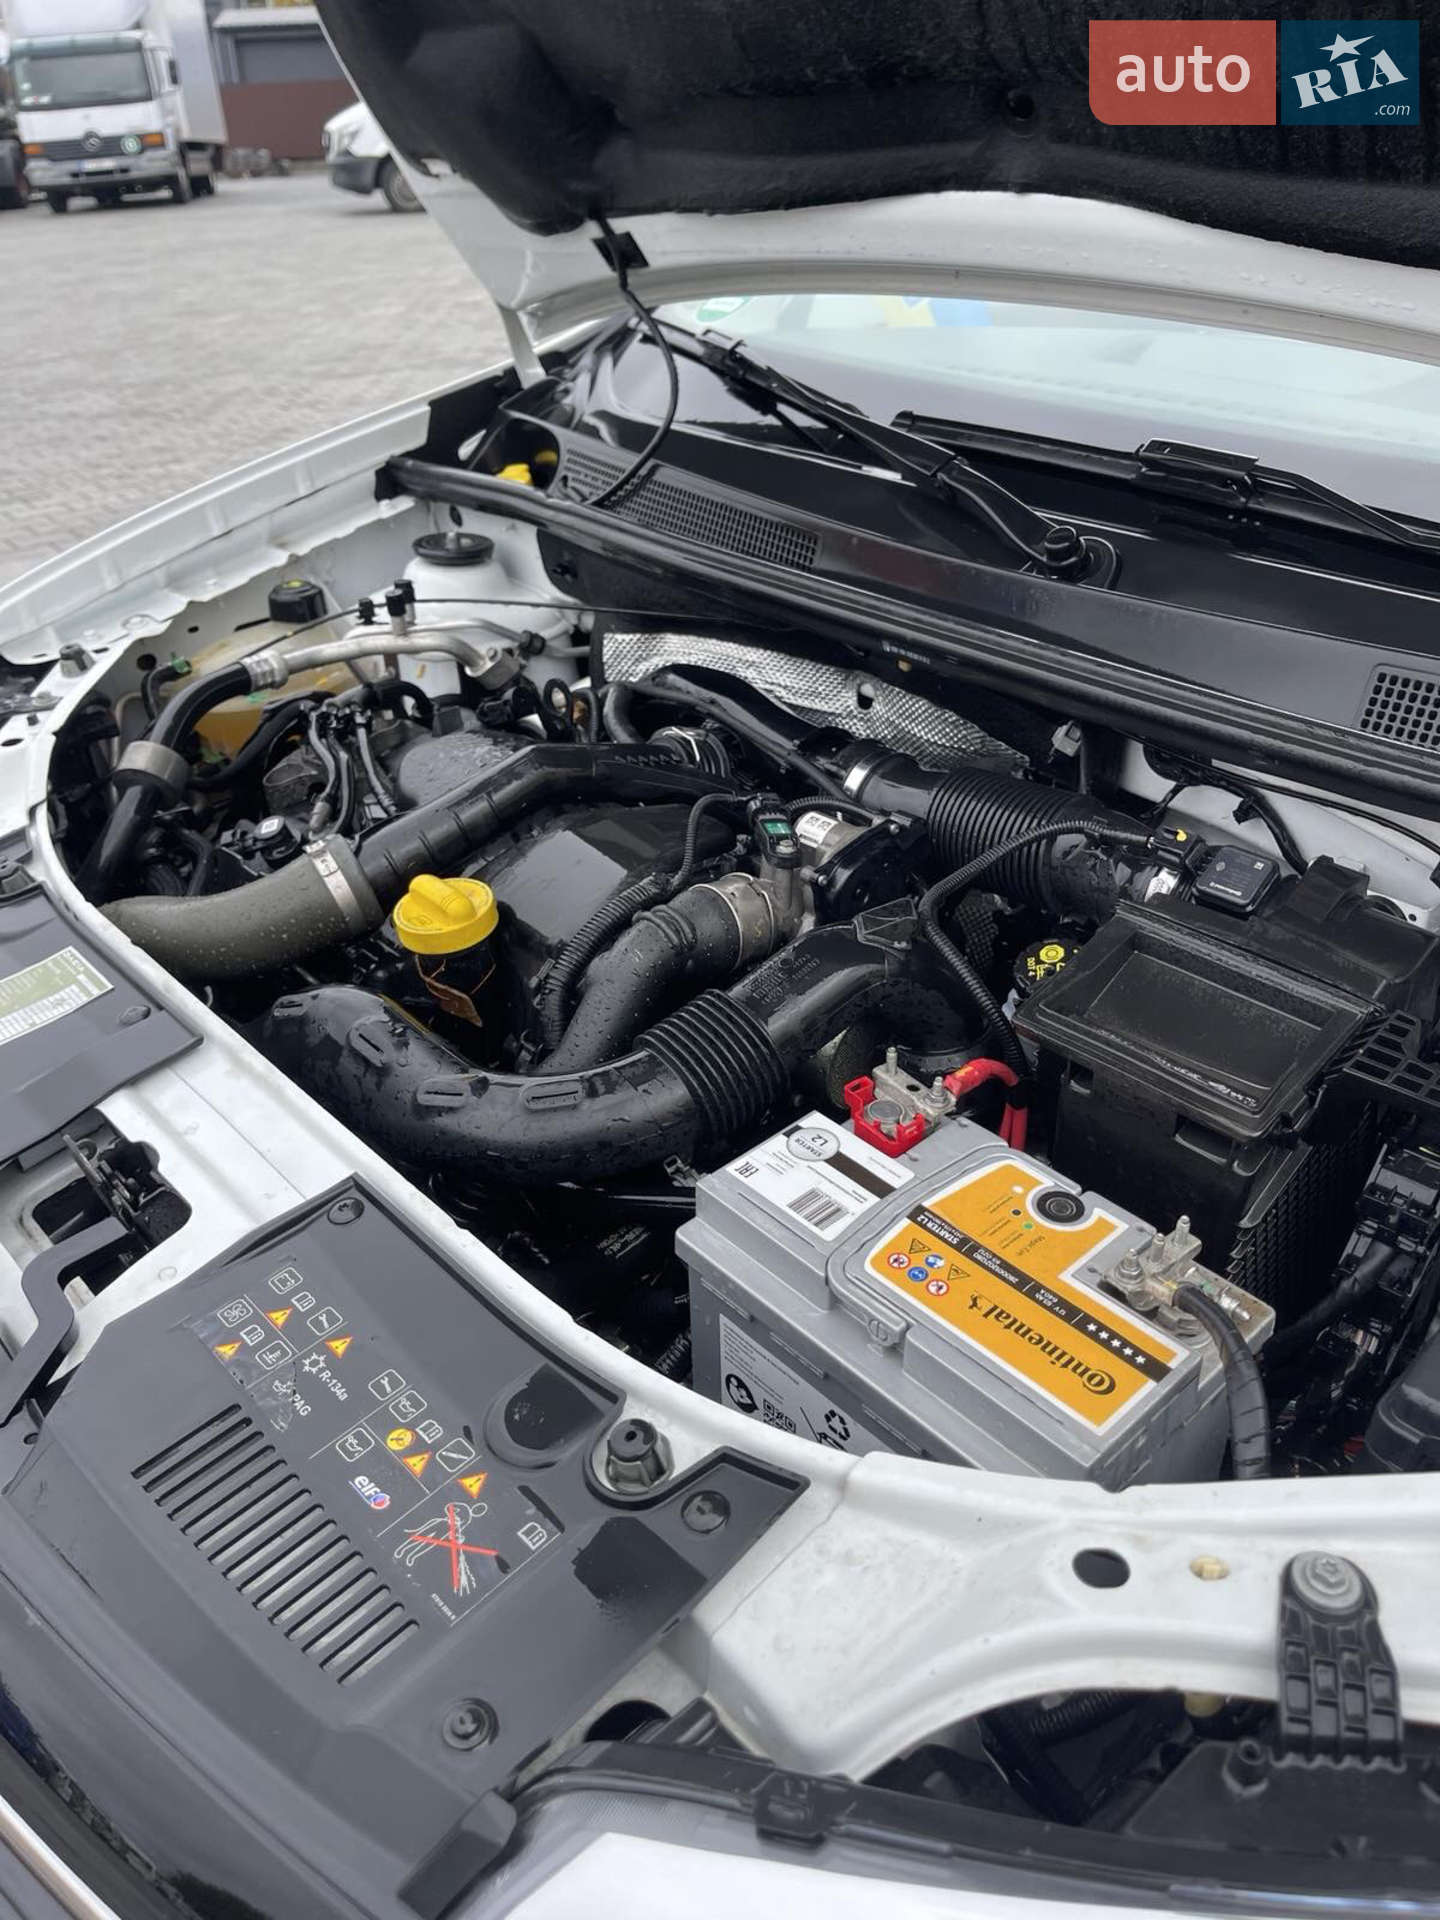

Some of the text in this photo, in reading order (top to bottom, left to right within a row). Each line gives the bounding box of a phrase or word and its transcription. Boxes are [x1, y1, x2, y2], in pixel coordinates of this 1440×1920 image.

[1027, 957, 1036, 970] DOT
[793, 1136, 825, 1158] STARTER
[811, 1134, 828, 1147] L2
[917, 1214, 928, 1225] L2
[927, 1221, 960, 1245] STARTER
[982, 1305, 1117, 1396] Continental
[318, 1369, 349, 1402] R-134a
[292, 1393, 312, 1417] PAG
[353, 1475, 381, 1501] elf
